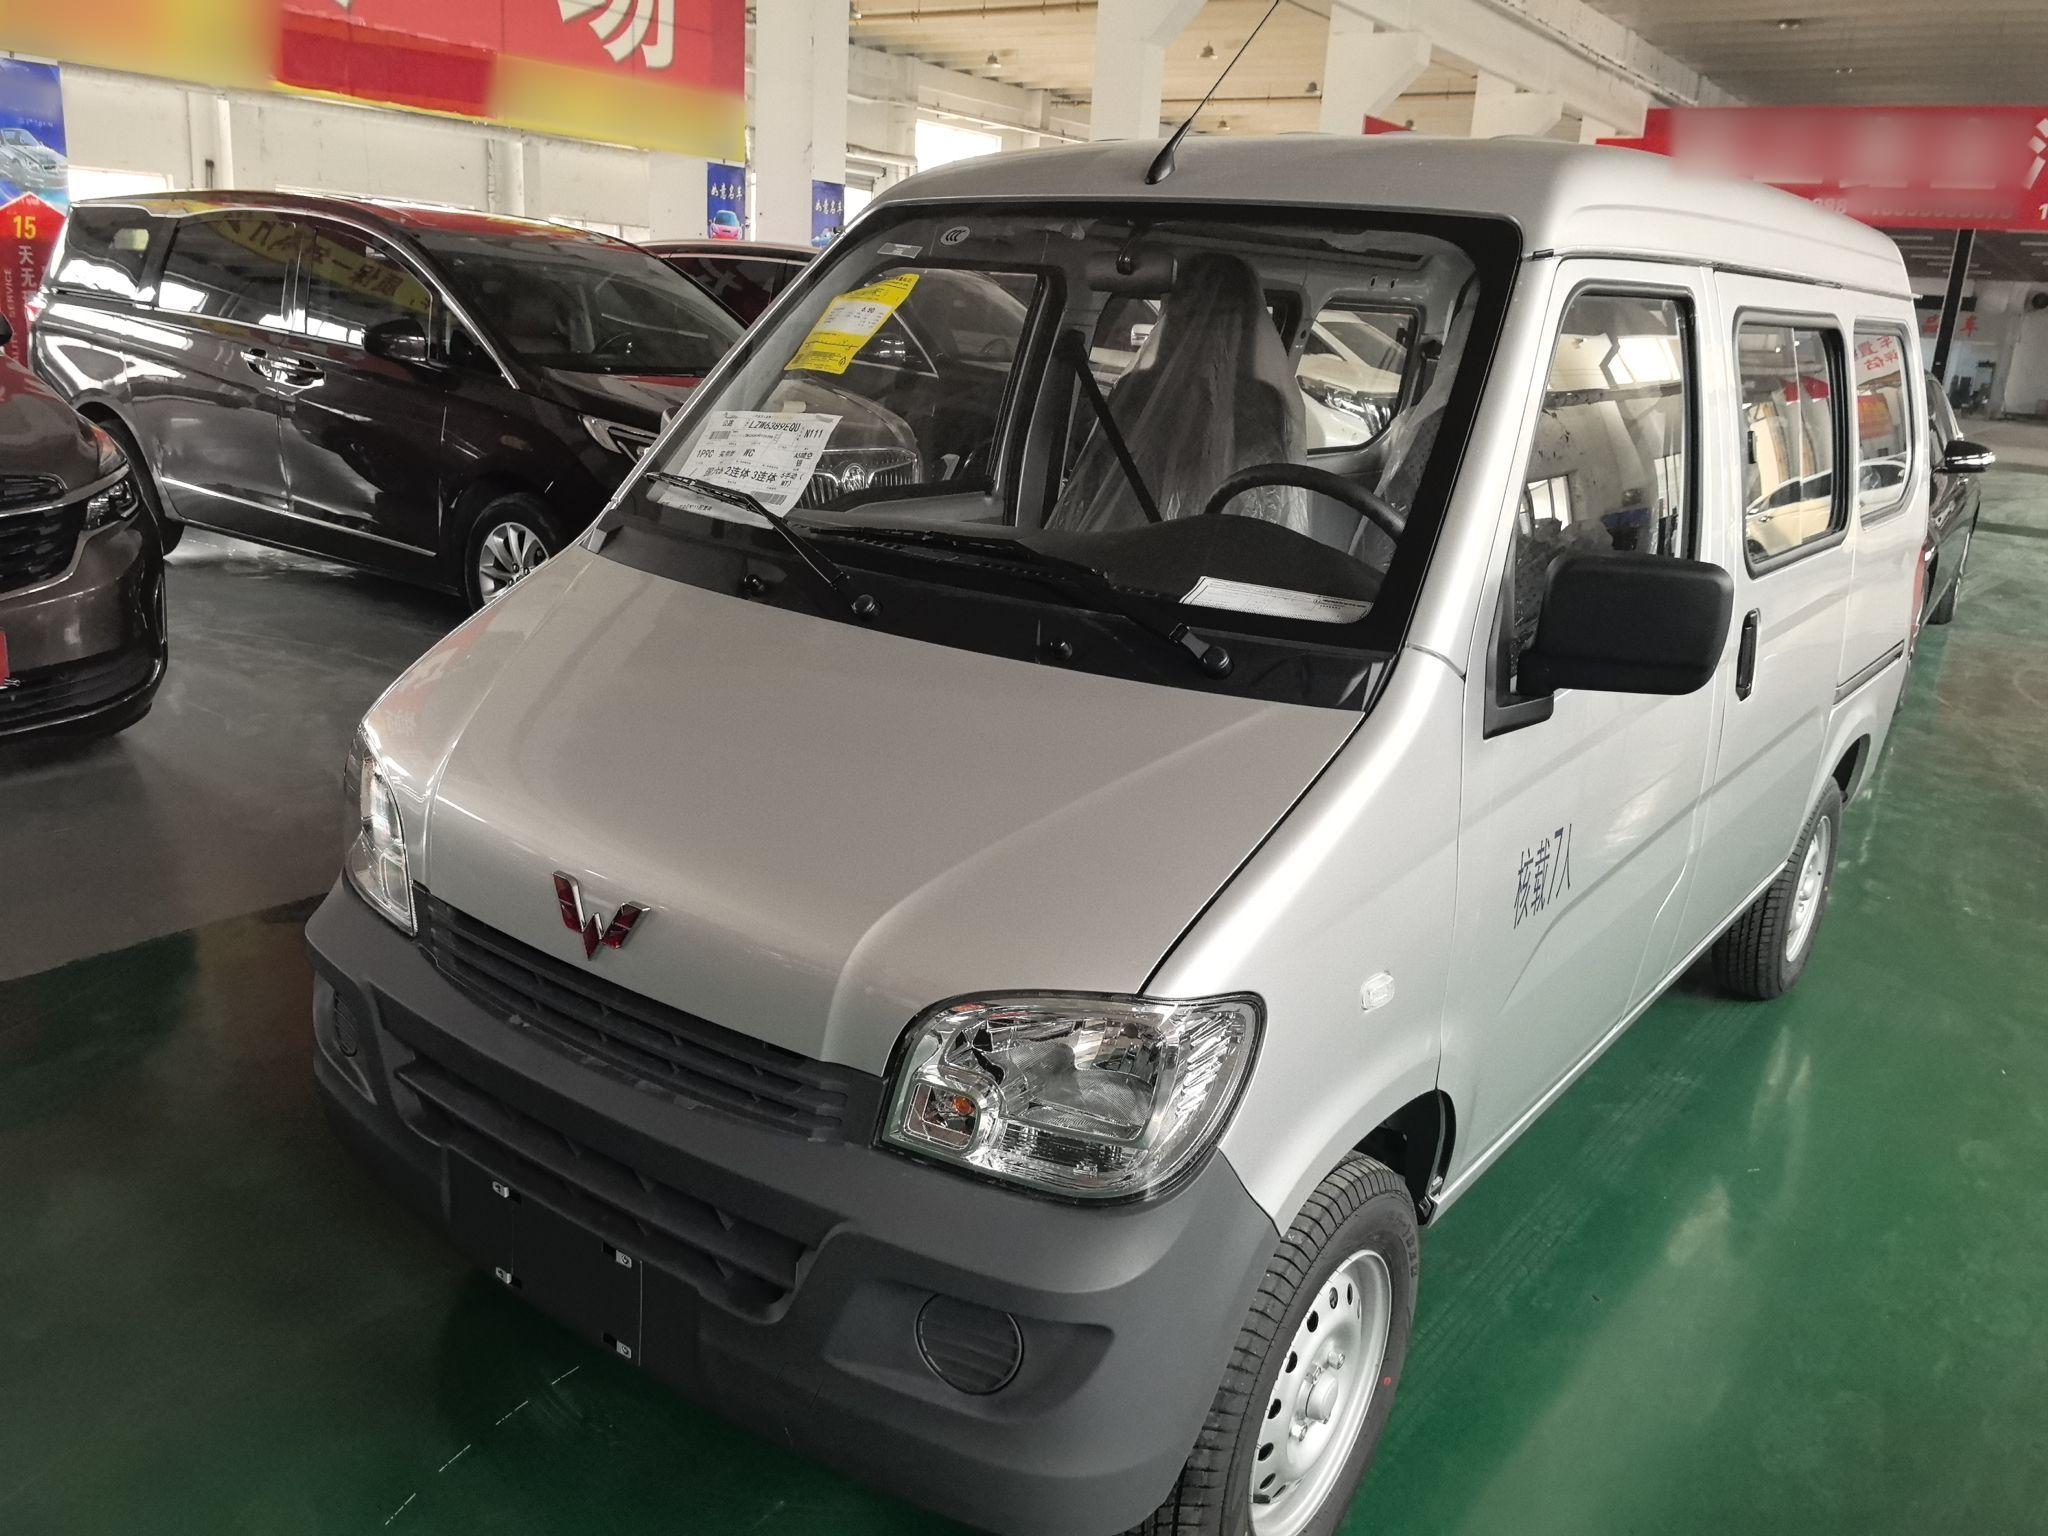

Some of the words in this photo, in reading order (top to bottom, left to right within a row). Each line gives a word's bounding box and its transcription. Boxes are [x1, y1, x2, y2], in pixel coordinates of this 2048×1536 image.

[13, 215, 37, 240] 15
[749, 420, 801, 432] LZW6389EQU
[803, 429, 823, 438] N111
[724, 466, 751, 480] 2连体
[751, 471, 777, 484] 3连体
